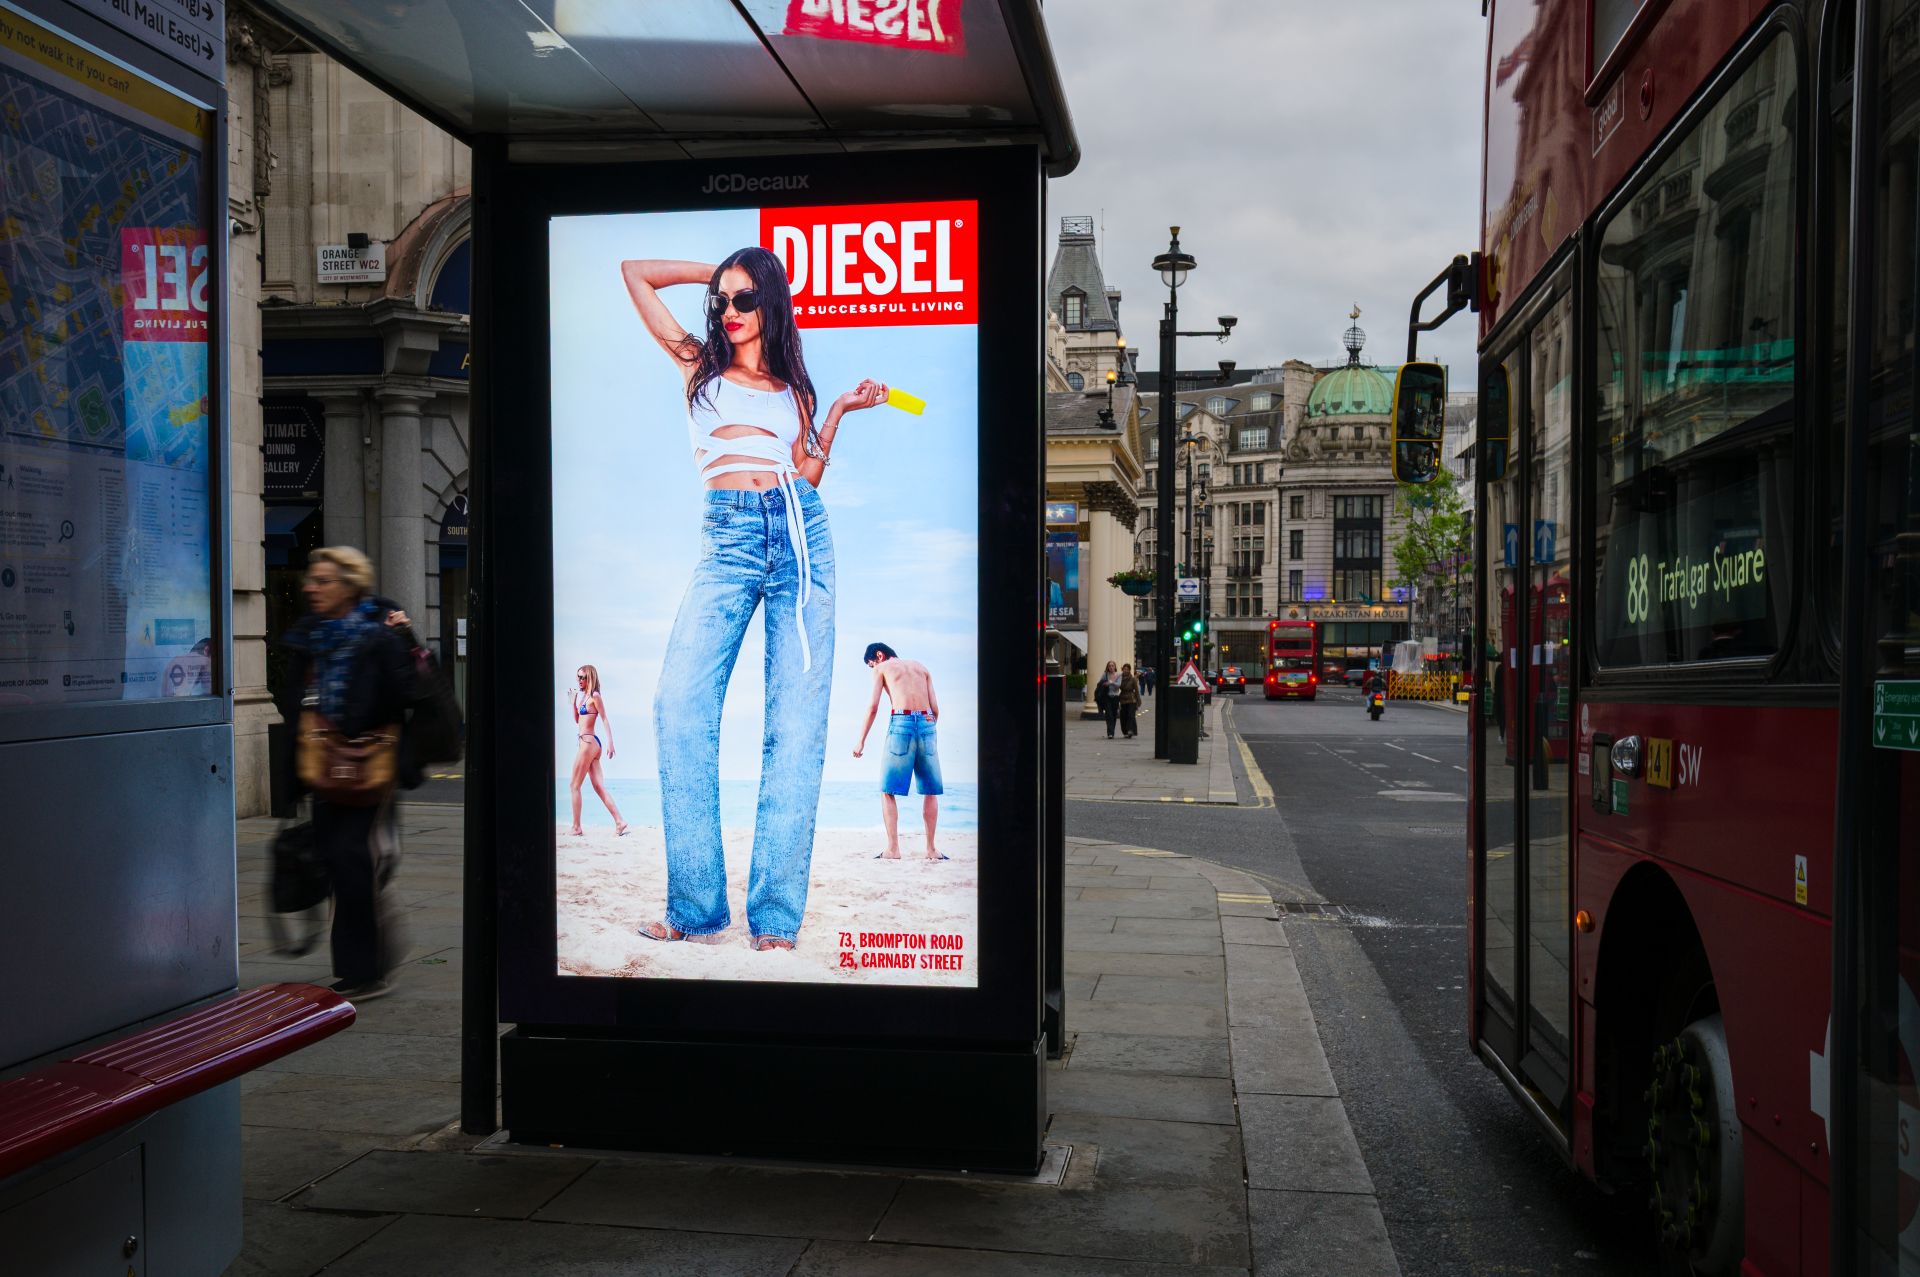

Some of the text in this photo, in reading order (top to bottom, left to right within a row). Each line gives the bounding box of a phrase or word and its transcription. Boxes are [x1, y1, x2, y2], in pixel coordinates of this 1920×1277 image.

[135, 2, 165, 35] Mall
[169, 21, 201, 56] East)
[17, 30, 36, 49] not
[39, 41, 64, 64] walk
[66, 55, 75, 69] it
[76, 59, 85, 73] if
[87, 66, 105, 84] you
[108, 76, 130, 95] can?
[1599, 86, 1618, 143] global
[702, 173, 809, 194] JCDecaux
[322, 249, 361, 260] ORANGE
[773, 219, 964, 297] DIESEL
[322, 259, 380, 271] STREET WC2
[808, 303, 907, 315] SUCCESSFUL
[911, 301, 964, 313] LIVING
[266, 443, 296, 455] DINING
[1628, 545, 1765, 624] 88 Trafalgar Square
[1058, 607, 1075, 616] SEA
[1313, 608, 1405, 618] KAZAKHSTAN HOUSE
[1679, 743, 1703, 788] SW
[838, 931, 964, 950] 73, BROMPTON ROAD
[839, 951, 964, 970] 25, CARNABY STREET
